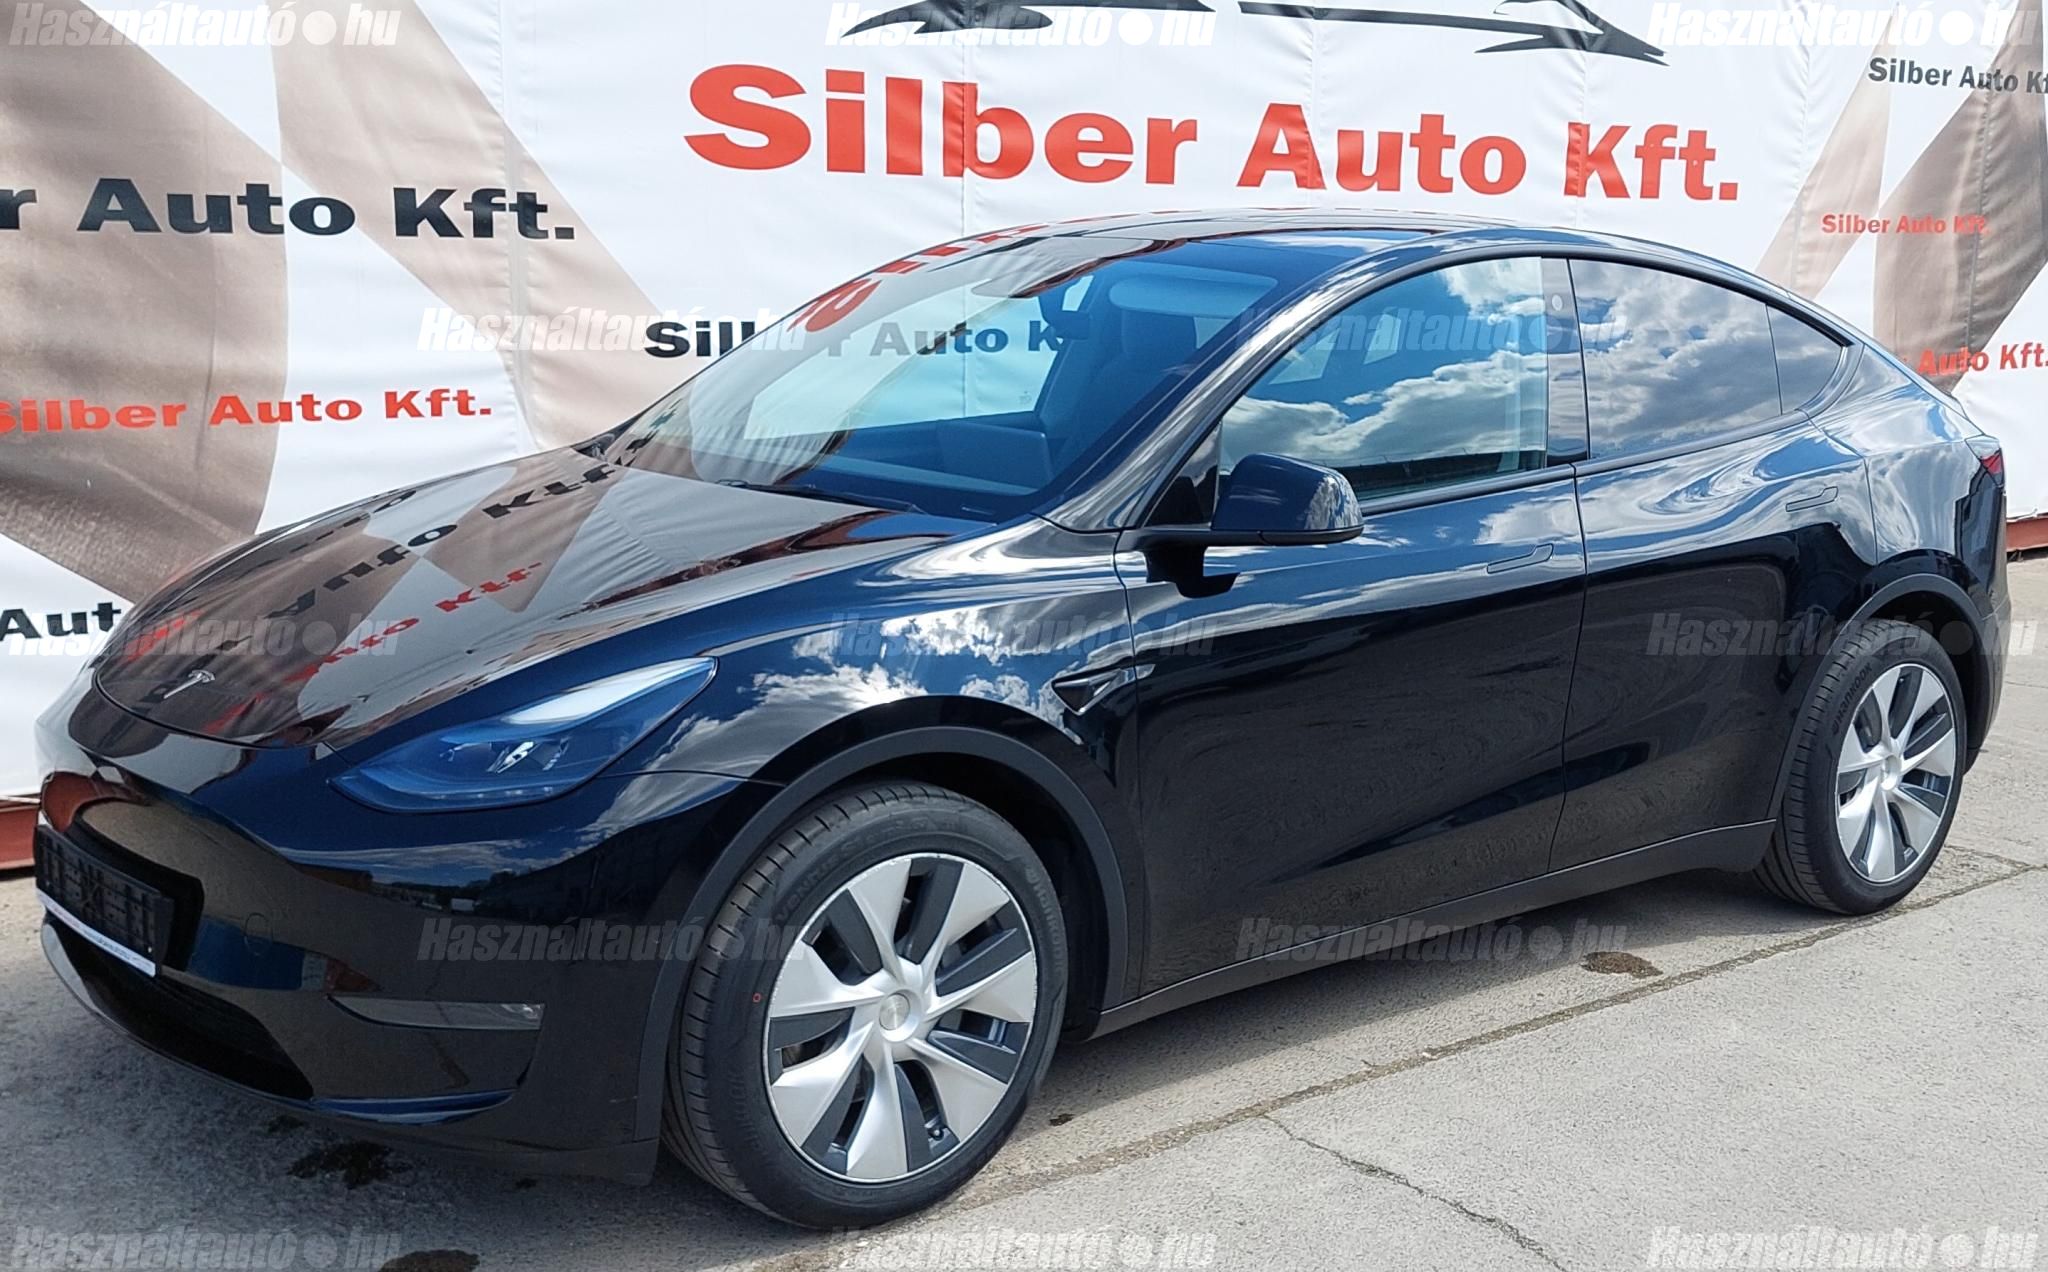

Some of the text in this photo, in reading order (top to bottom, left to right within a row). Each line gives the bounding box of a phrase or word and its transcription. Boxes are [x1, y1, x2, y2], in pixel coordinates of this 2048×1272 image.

[1868, 57, 1953, 87] Silber
[1959, 65, 2019, 93] Auto
[684, 63, 1738, 201] Silber Auto Kft.
[77, 177, 356, 236] Auto
[393, 186, 576, 240] Kft.
[1822, 213, 1891, 234] Silber
[1896, 215, 1946, 234] Auto
[869, 320, 1009, 356] Auto
[1917, 346, 1989, 376] Auto
[208, 394, 362, 425] Auto
[384, 388, 492, 420] Kft.
[0, 602, 122, 640] Aut
